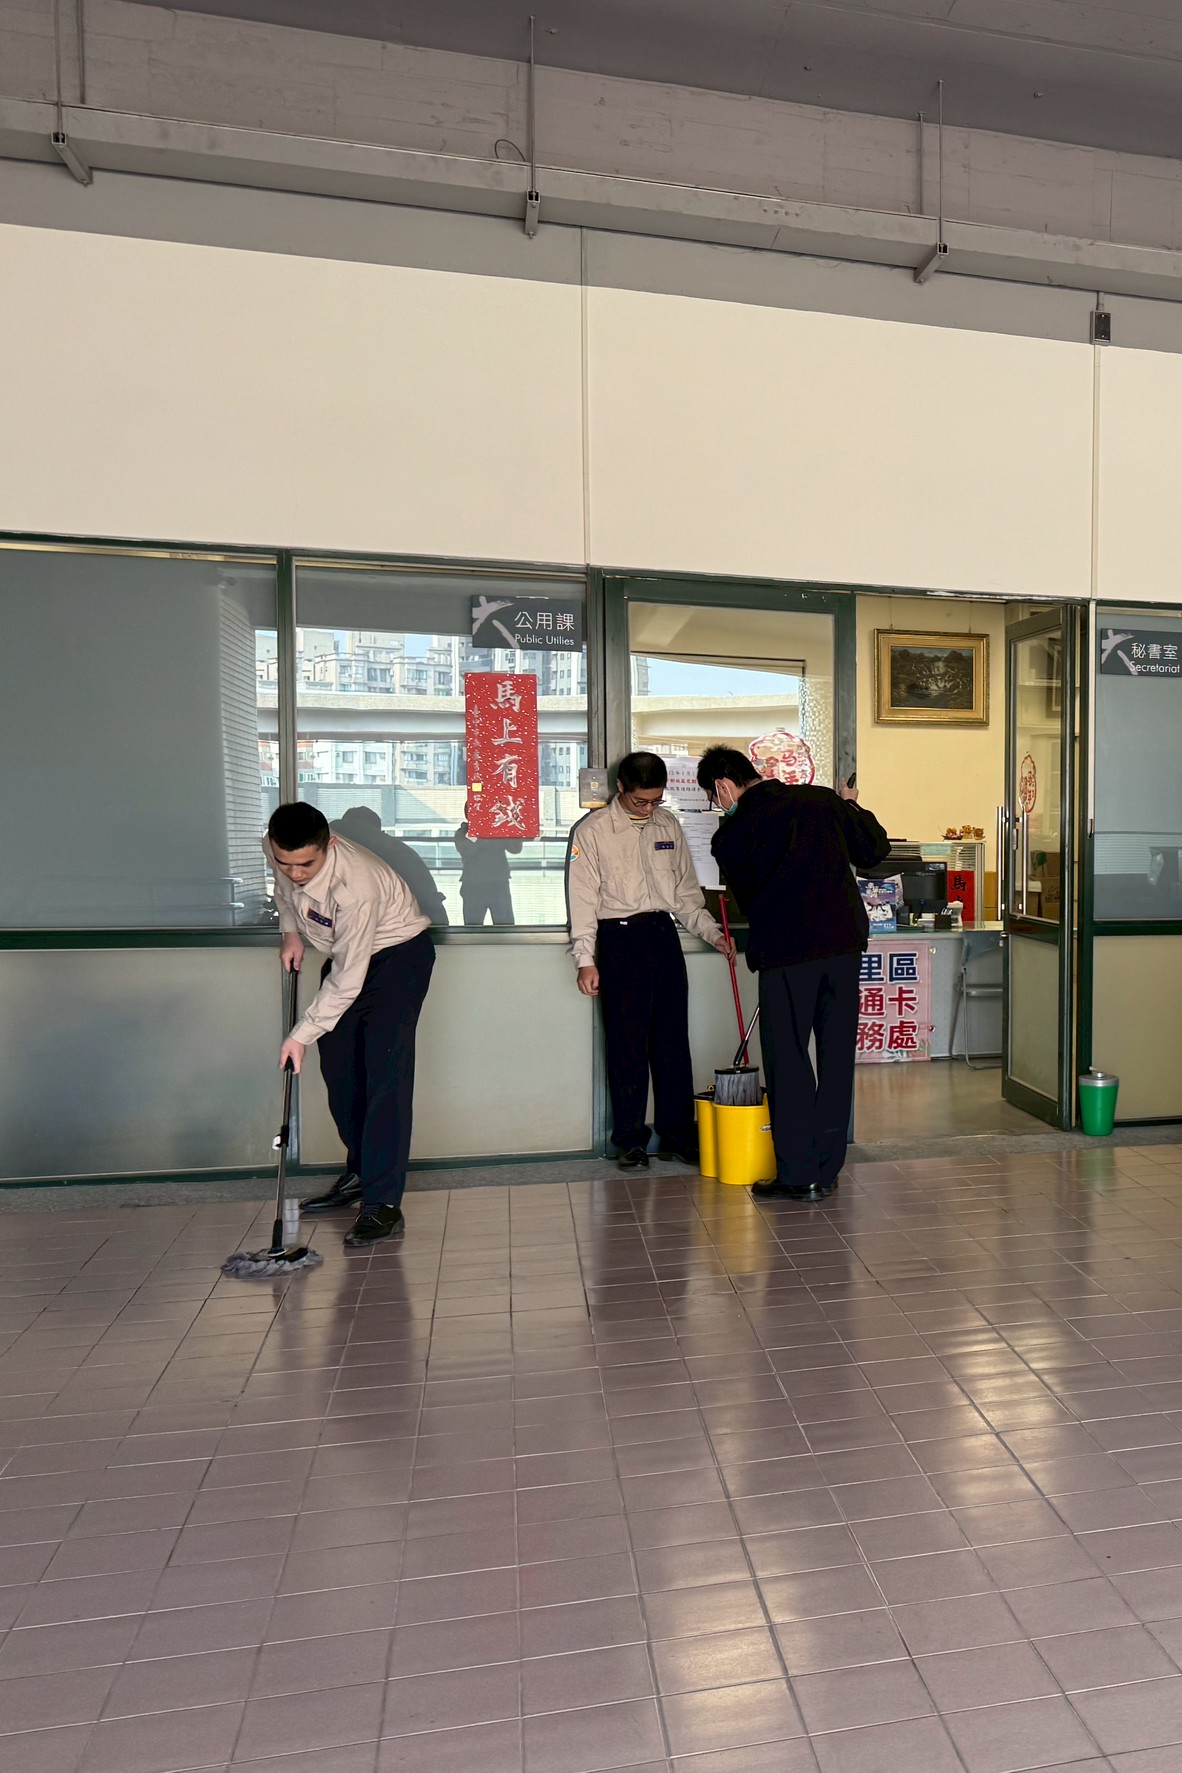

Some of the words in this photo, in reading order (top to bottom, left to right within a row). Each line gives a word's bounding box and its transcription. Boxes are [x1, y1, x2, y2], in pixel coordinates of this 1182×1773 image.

[514, 611, 575, 631] 公用課
[515, 633, 543, 645] Public
[546, 635, 575, 646] Utilies
[1131, 642, 1179, 660] 秘書室
[1129, 660, 1180, 674] Secretariat
[489, 680, 526, 831] 馬上有錢
[860, 952, 919, 982] 里區
[859, 985, 918, 1017] 通卡
[856, 1020, 919, 1051] 務處
